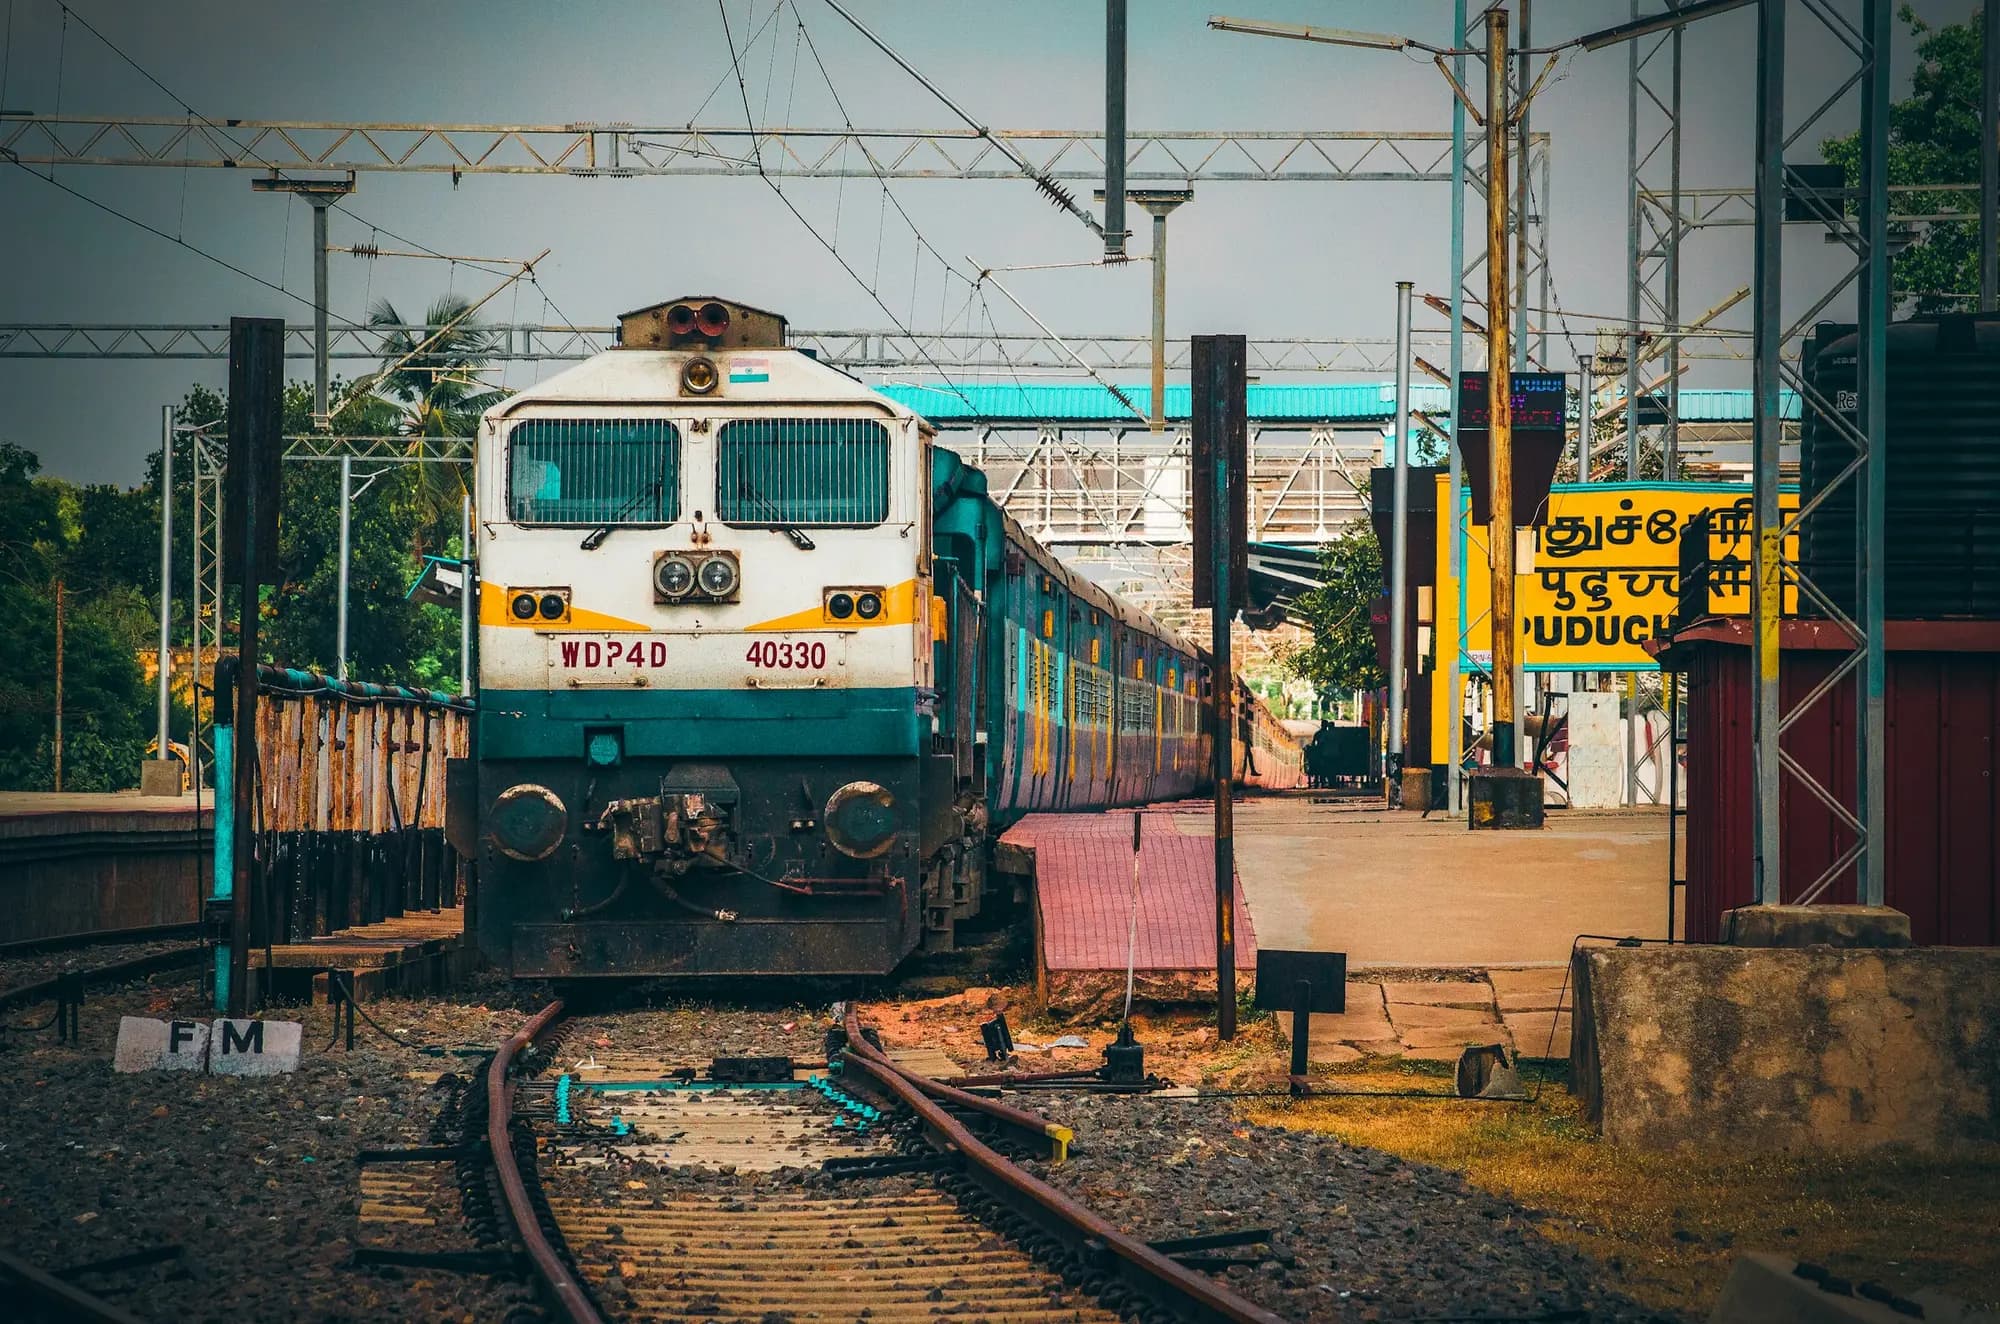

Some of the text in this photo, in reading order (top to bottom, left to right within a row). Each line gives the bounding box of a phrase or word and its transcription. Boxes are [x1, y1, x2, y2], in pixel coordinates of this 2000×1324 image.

[561, 641, 826, 669] WDP4D 40330
[170, 1020, 264, 1055] F M
